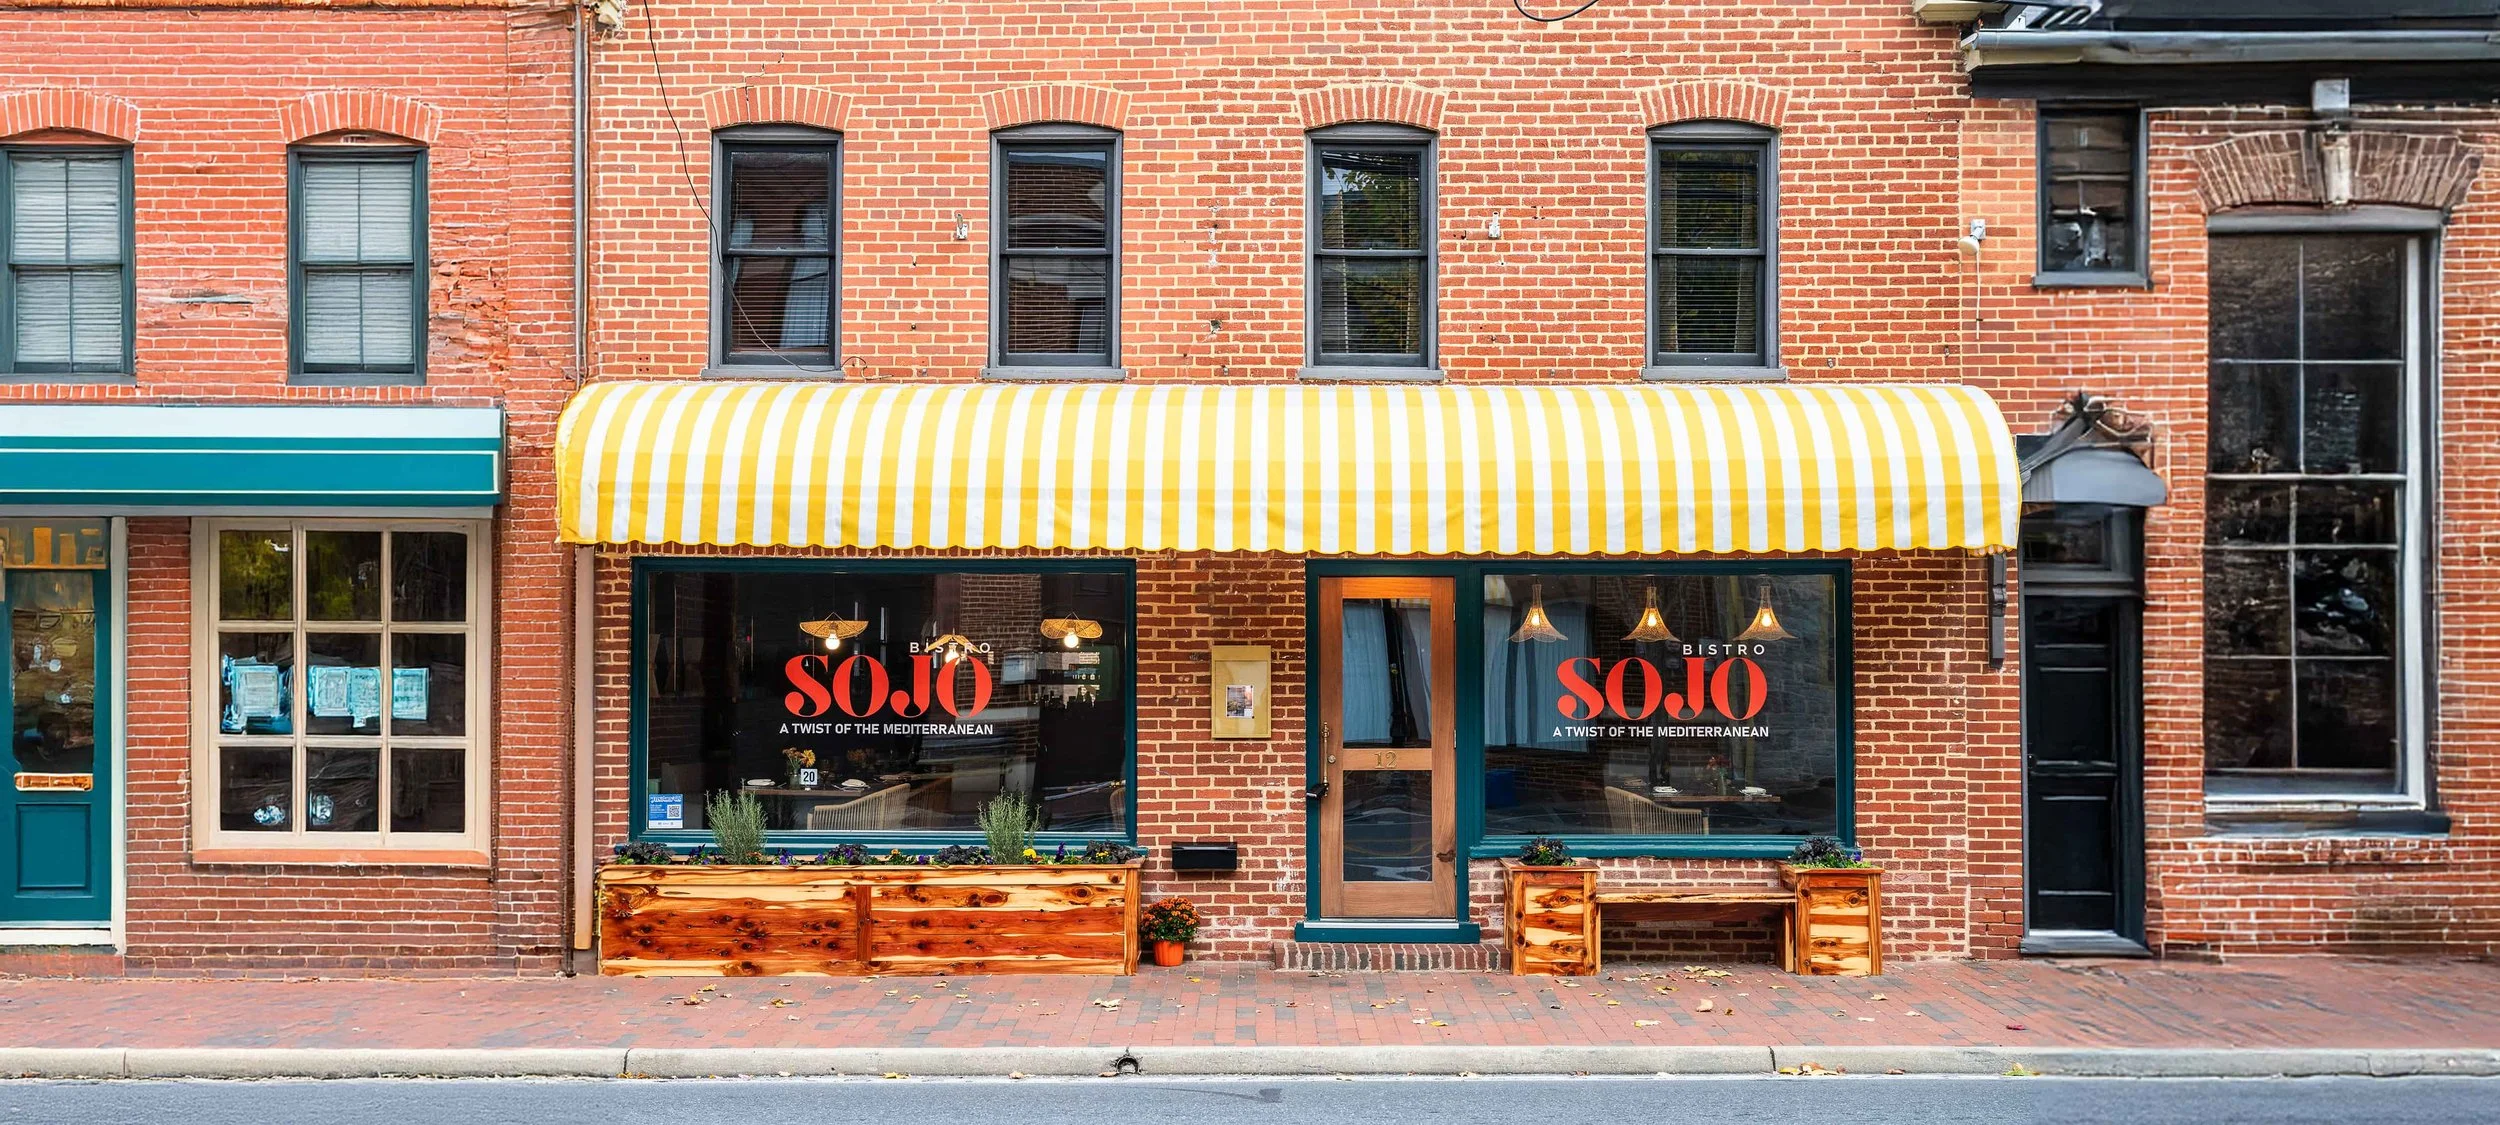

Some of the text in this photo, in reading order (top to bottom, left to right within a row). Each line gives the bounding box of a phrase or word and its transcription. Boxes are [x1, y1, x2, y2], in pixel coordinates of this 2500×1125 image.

[910, 642, 991, 653] BISTRO
[1682, 644, 1765, 655] BISTRO
[784, 654, 993, 718] SOJO
[1556, 657, 1768, 720] SOJO
[779, 723, 994, 735] A TWIST OF THE MEDITERRANEAN
[1553, 726, 1769, 737] A TWIST OF THE MEDITERRANEAN
[1374, 751, 1398, 769] 12
[803, 771, 815, 782] 20
